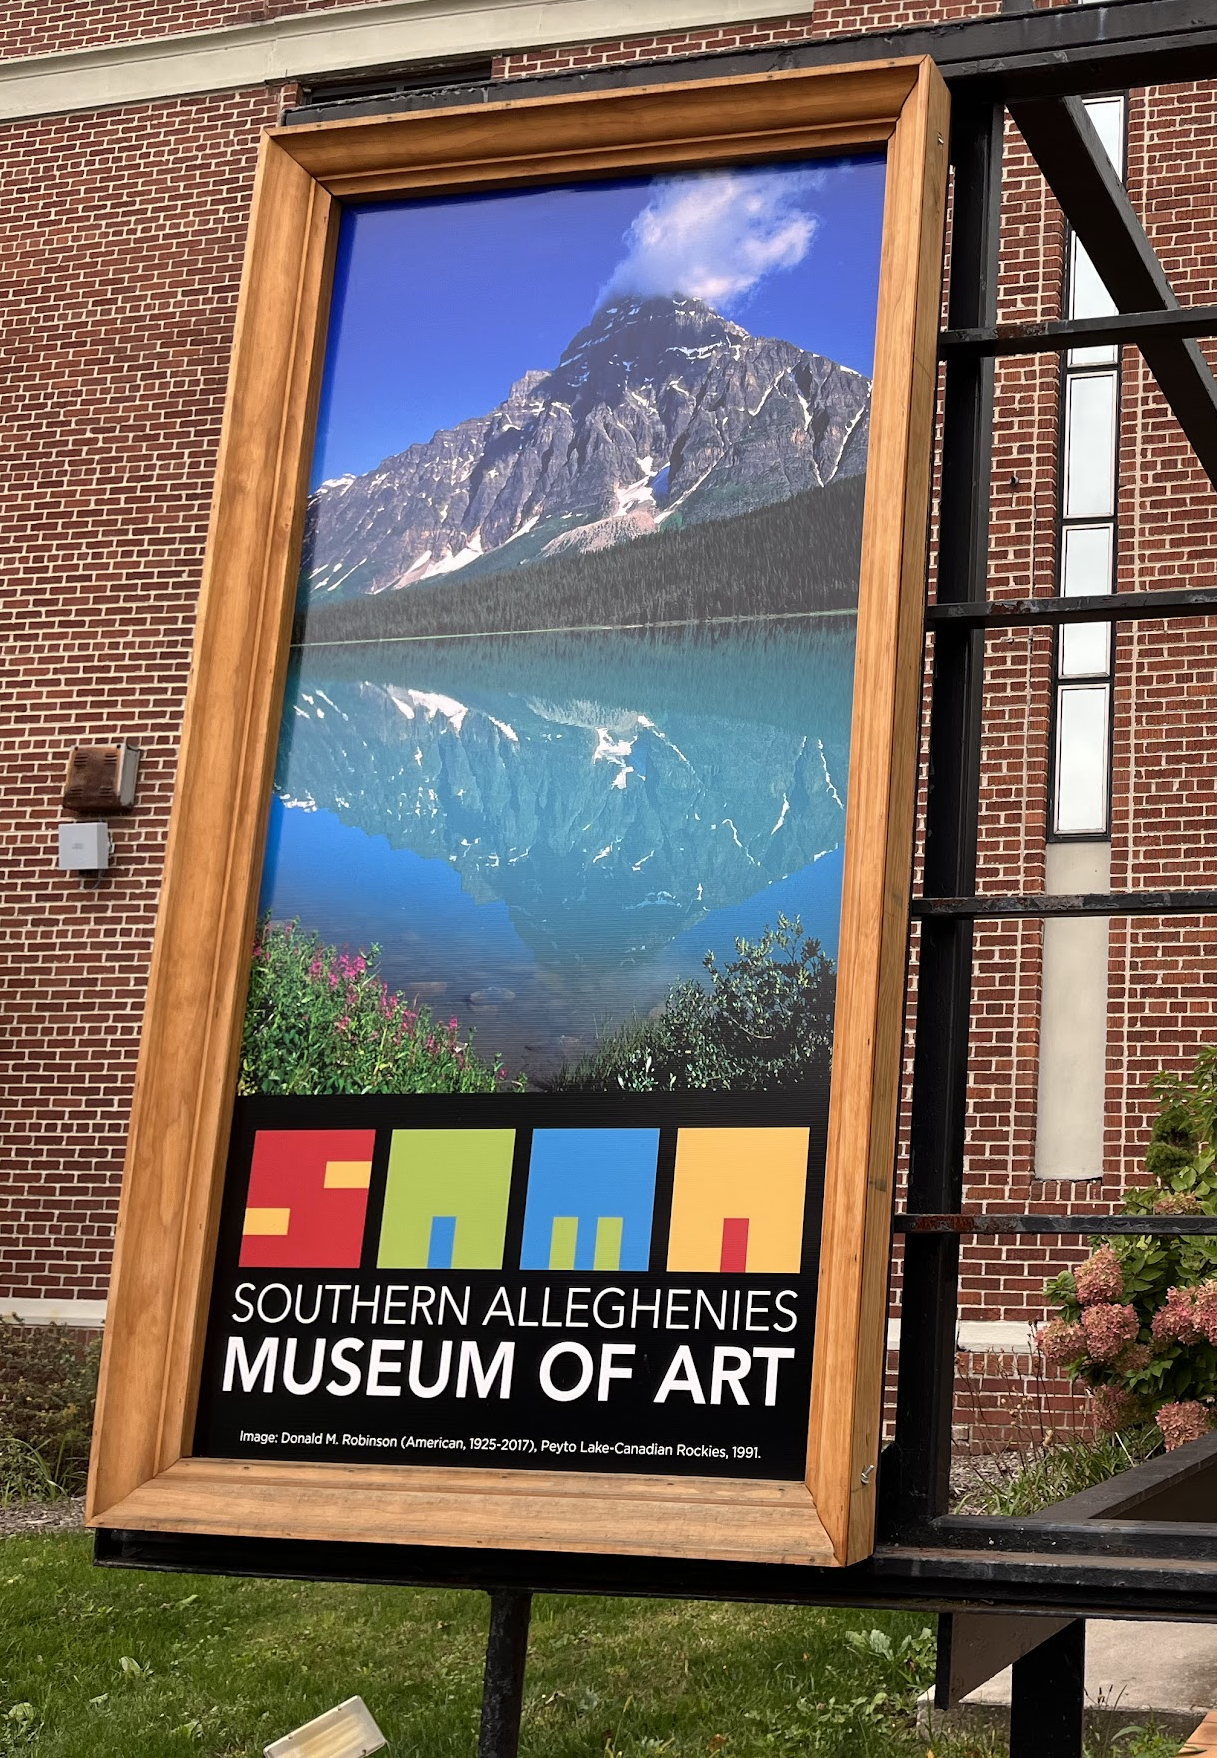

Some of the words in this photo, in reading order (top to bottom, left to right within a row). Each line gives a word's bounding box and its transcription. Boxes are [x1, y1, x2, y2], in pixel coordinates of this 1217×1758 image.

[231, 1282, 471, 1326] SOUTHERN
[482, 1285, 799, 1333] ALLEGHENIES
[222, 1336, 515, 1400] MUSEUM
[539, 1341, 637, 1402] OF
[653, 1344, 796, 1407] ART
[239, 1430, 279, 1444] Image:
[281, 1432, 324, 1445] Donald
[325, 1434, 339, 1446] M.
[341, 1434, 398, 1448] Robinson
[400, 1435, 467, 1451] (American,
[469, 1437, 538, 1453] 1925-2017),
[541, 1439, 577, 1455] Peyto
[580, 1441, 673, 1456] Lake-Canadian
[676, 1443, 729, 1460] Rockies,
[732, 1446, 762, 1459] 1991.
